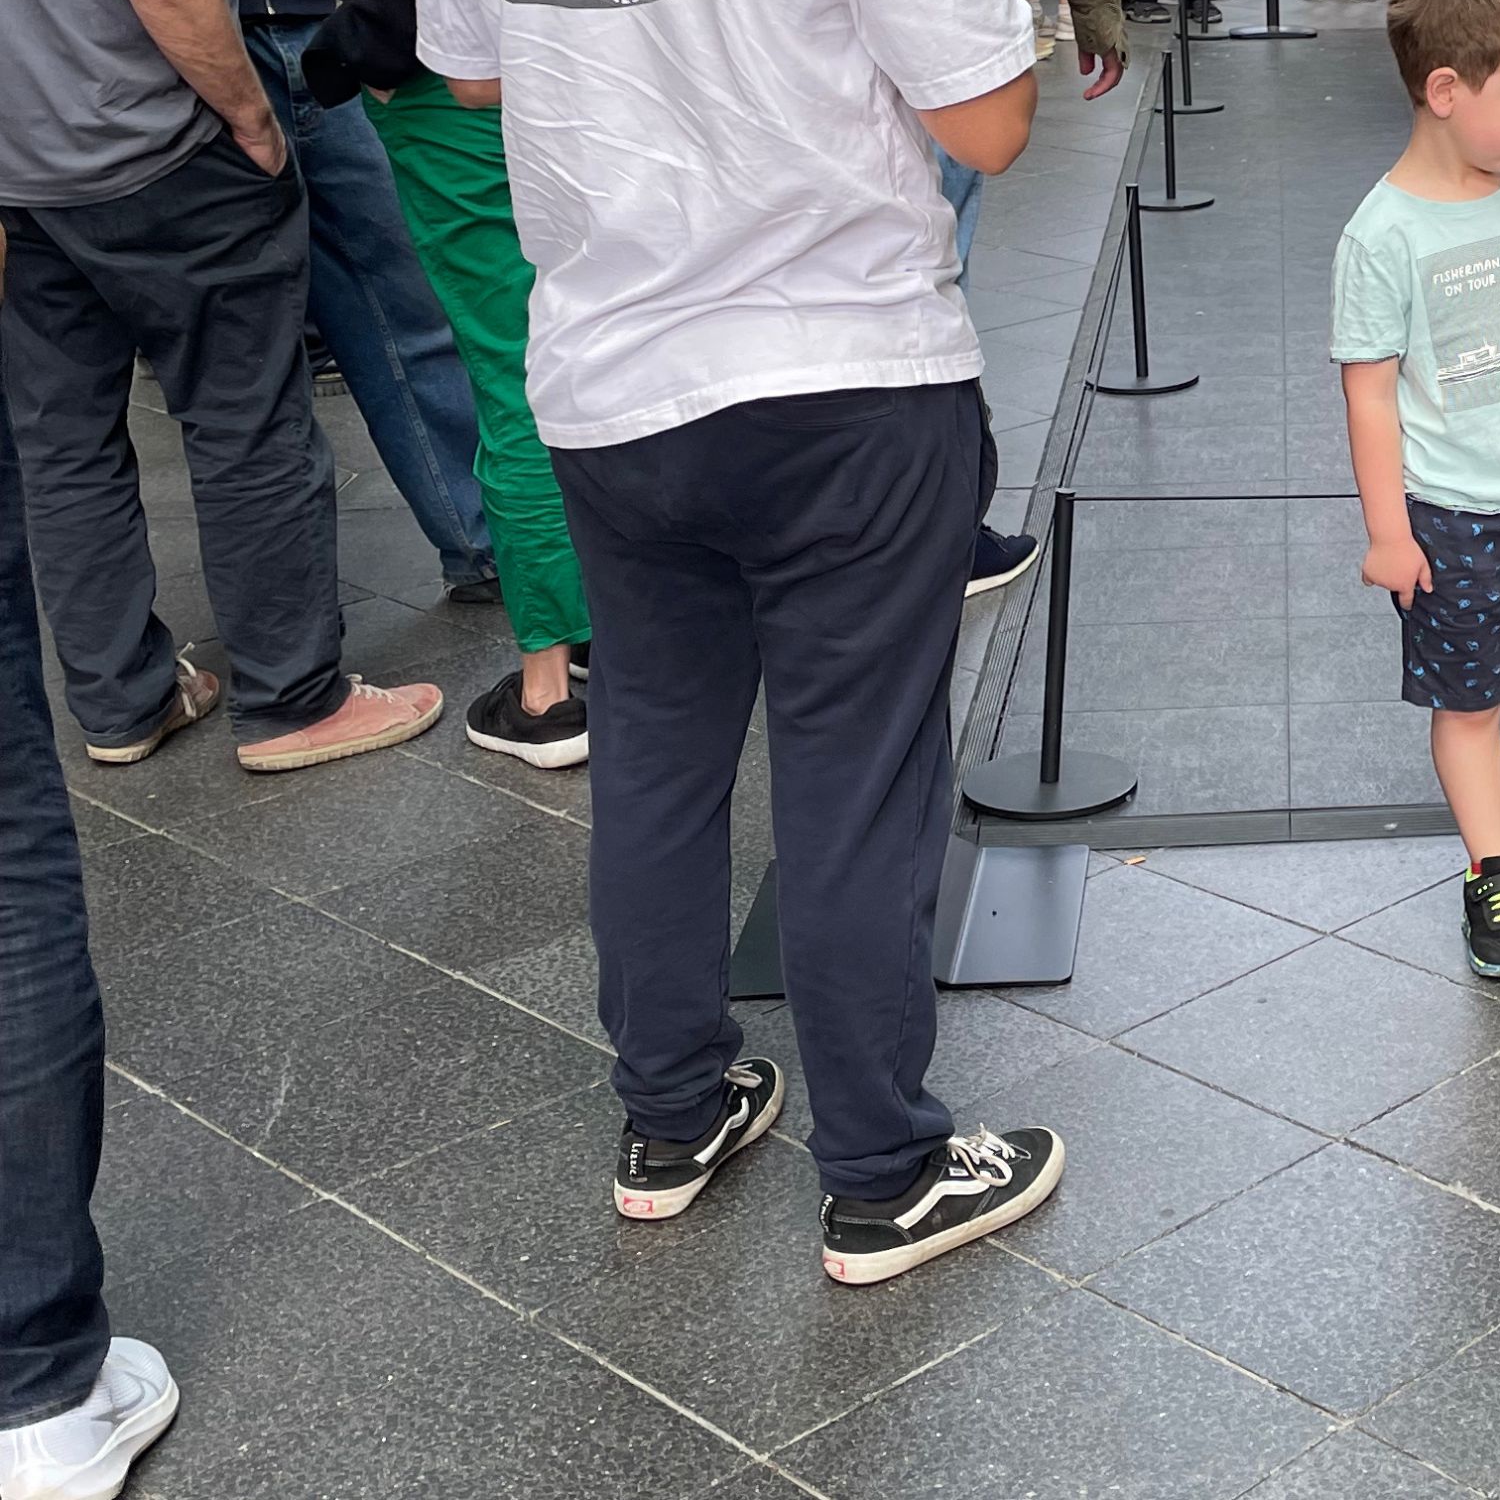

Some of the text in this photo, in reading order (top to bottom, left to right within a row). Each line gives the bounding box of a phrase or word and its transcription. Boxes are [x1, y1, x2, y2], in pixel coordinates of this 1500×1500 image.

[1432, 257, 1500, 285] FISHERMAN
[1444, 273, 1496, 297] ON TOUR
